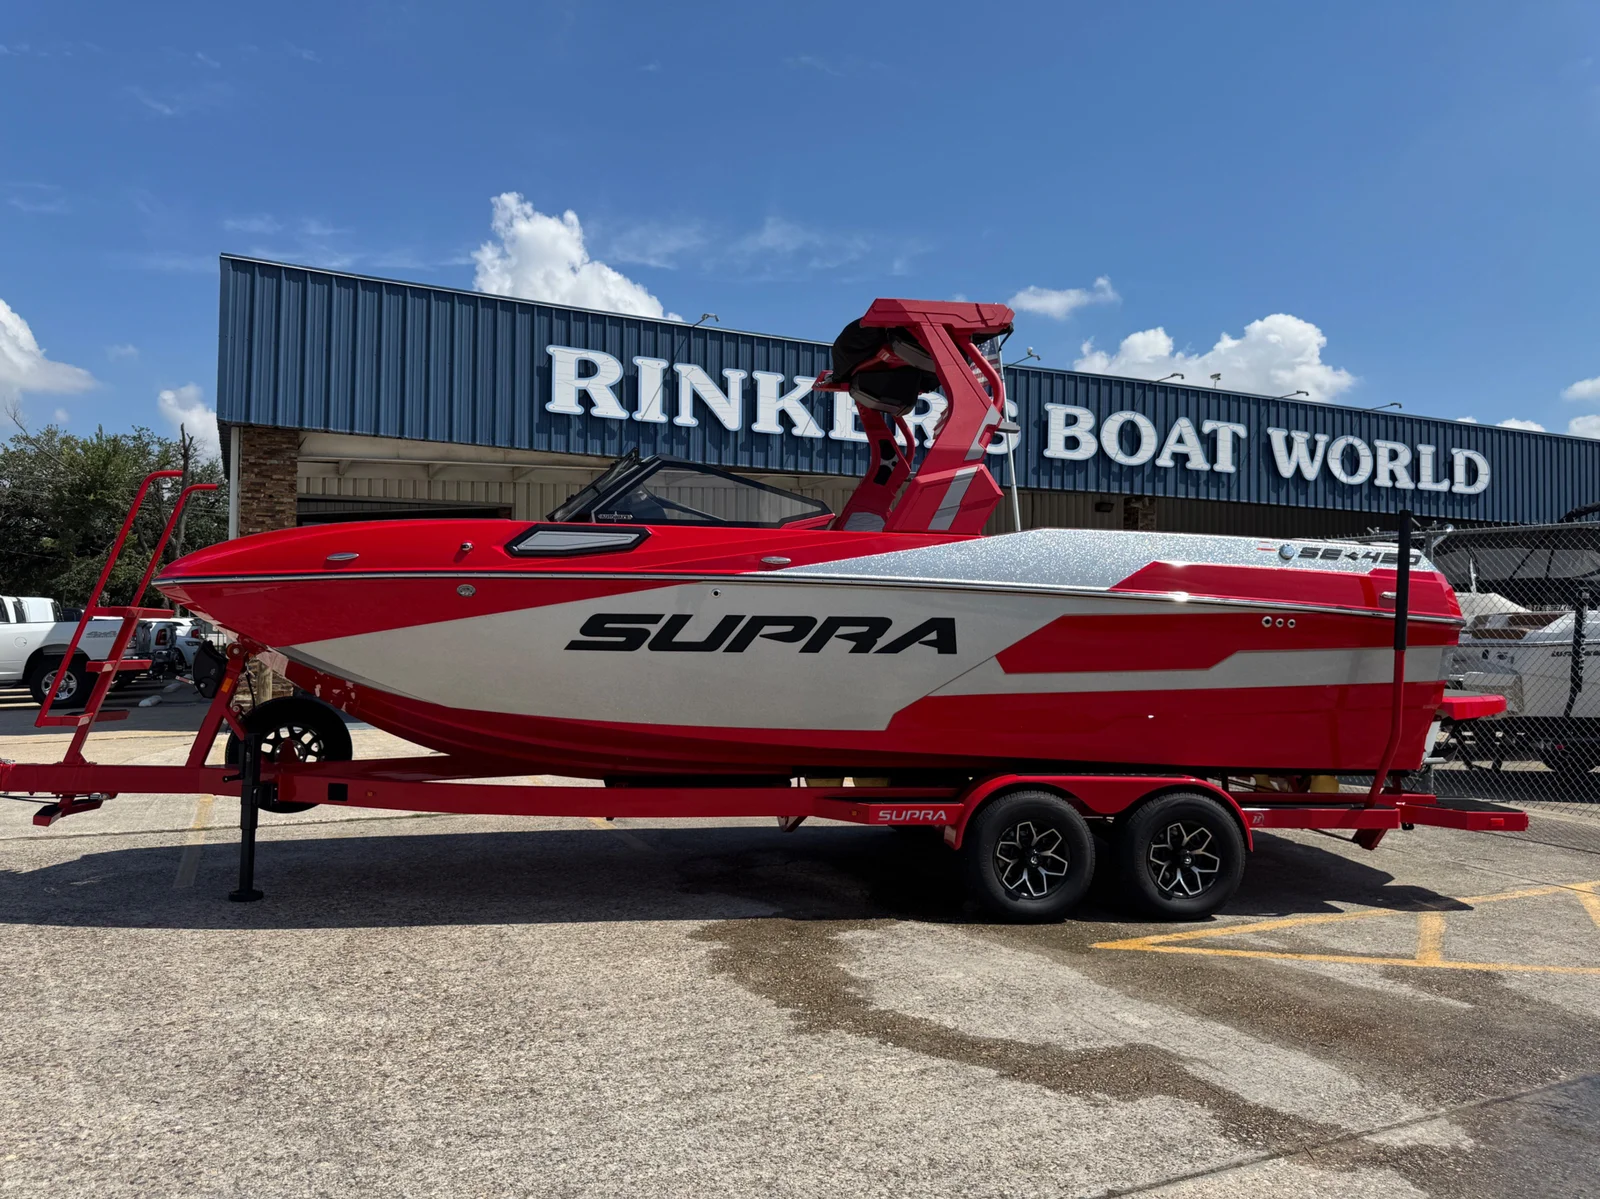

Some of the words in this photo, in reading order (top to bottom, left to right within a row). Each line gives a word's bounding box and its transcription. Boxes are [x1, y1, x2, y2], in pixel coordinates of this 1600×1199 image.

[1043, 402, 1247, 473] BOAT
[1266, 427, 1491, 495] WORLD
[564, 613, 957, 654] SUPRA
[877, 810, 946, 821] SUPRA
